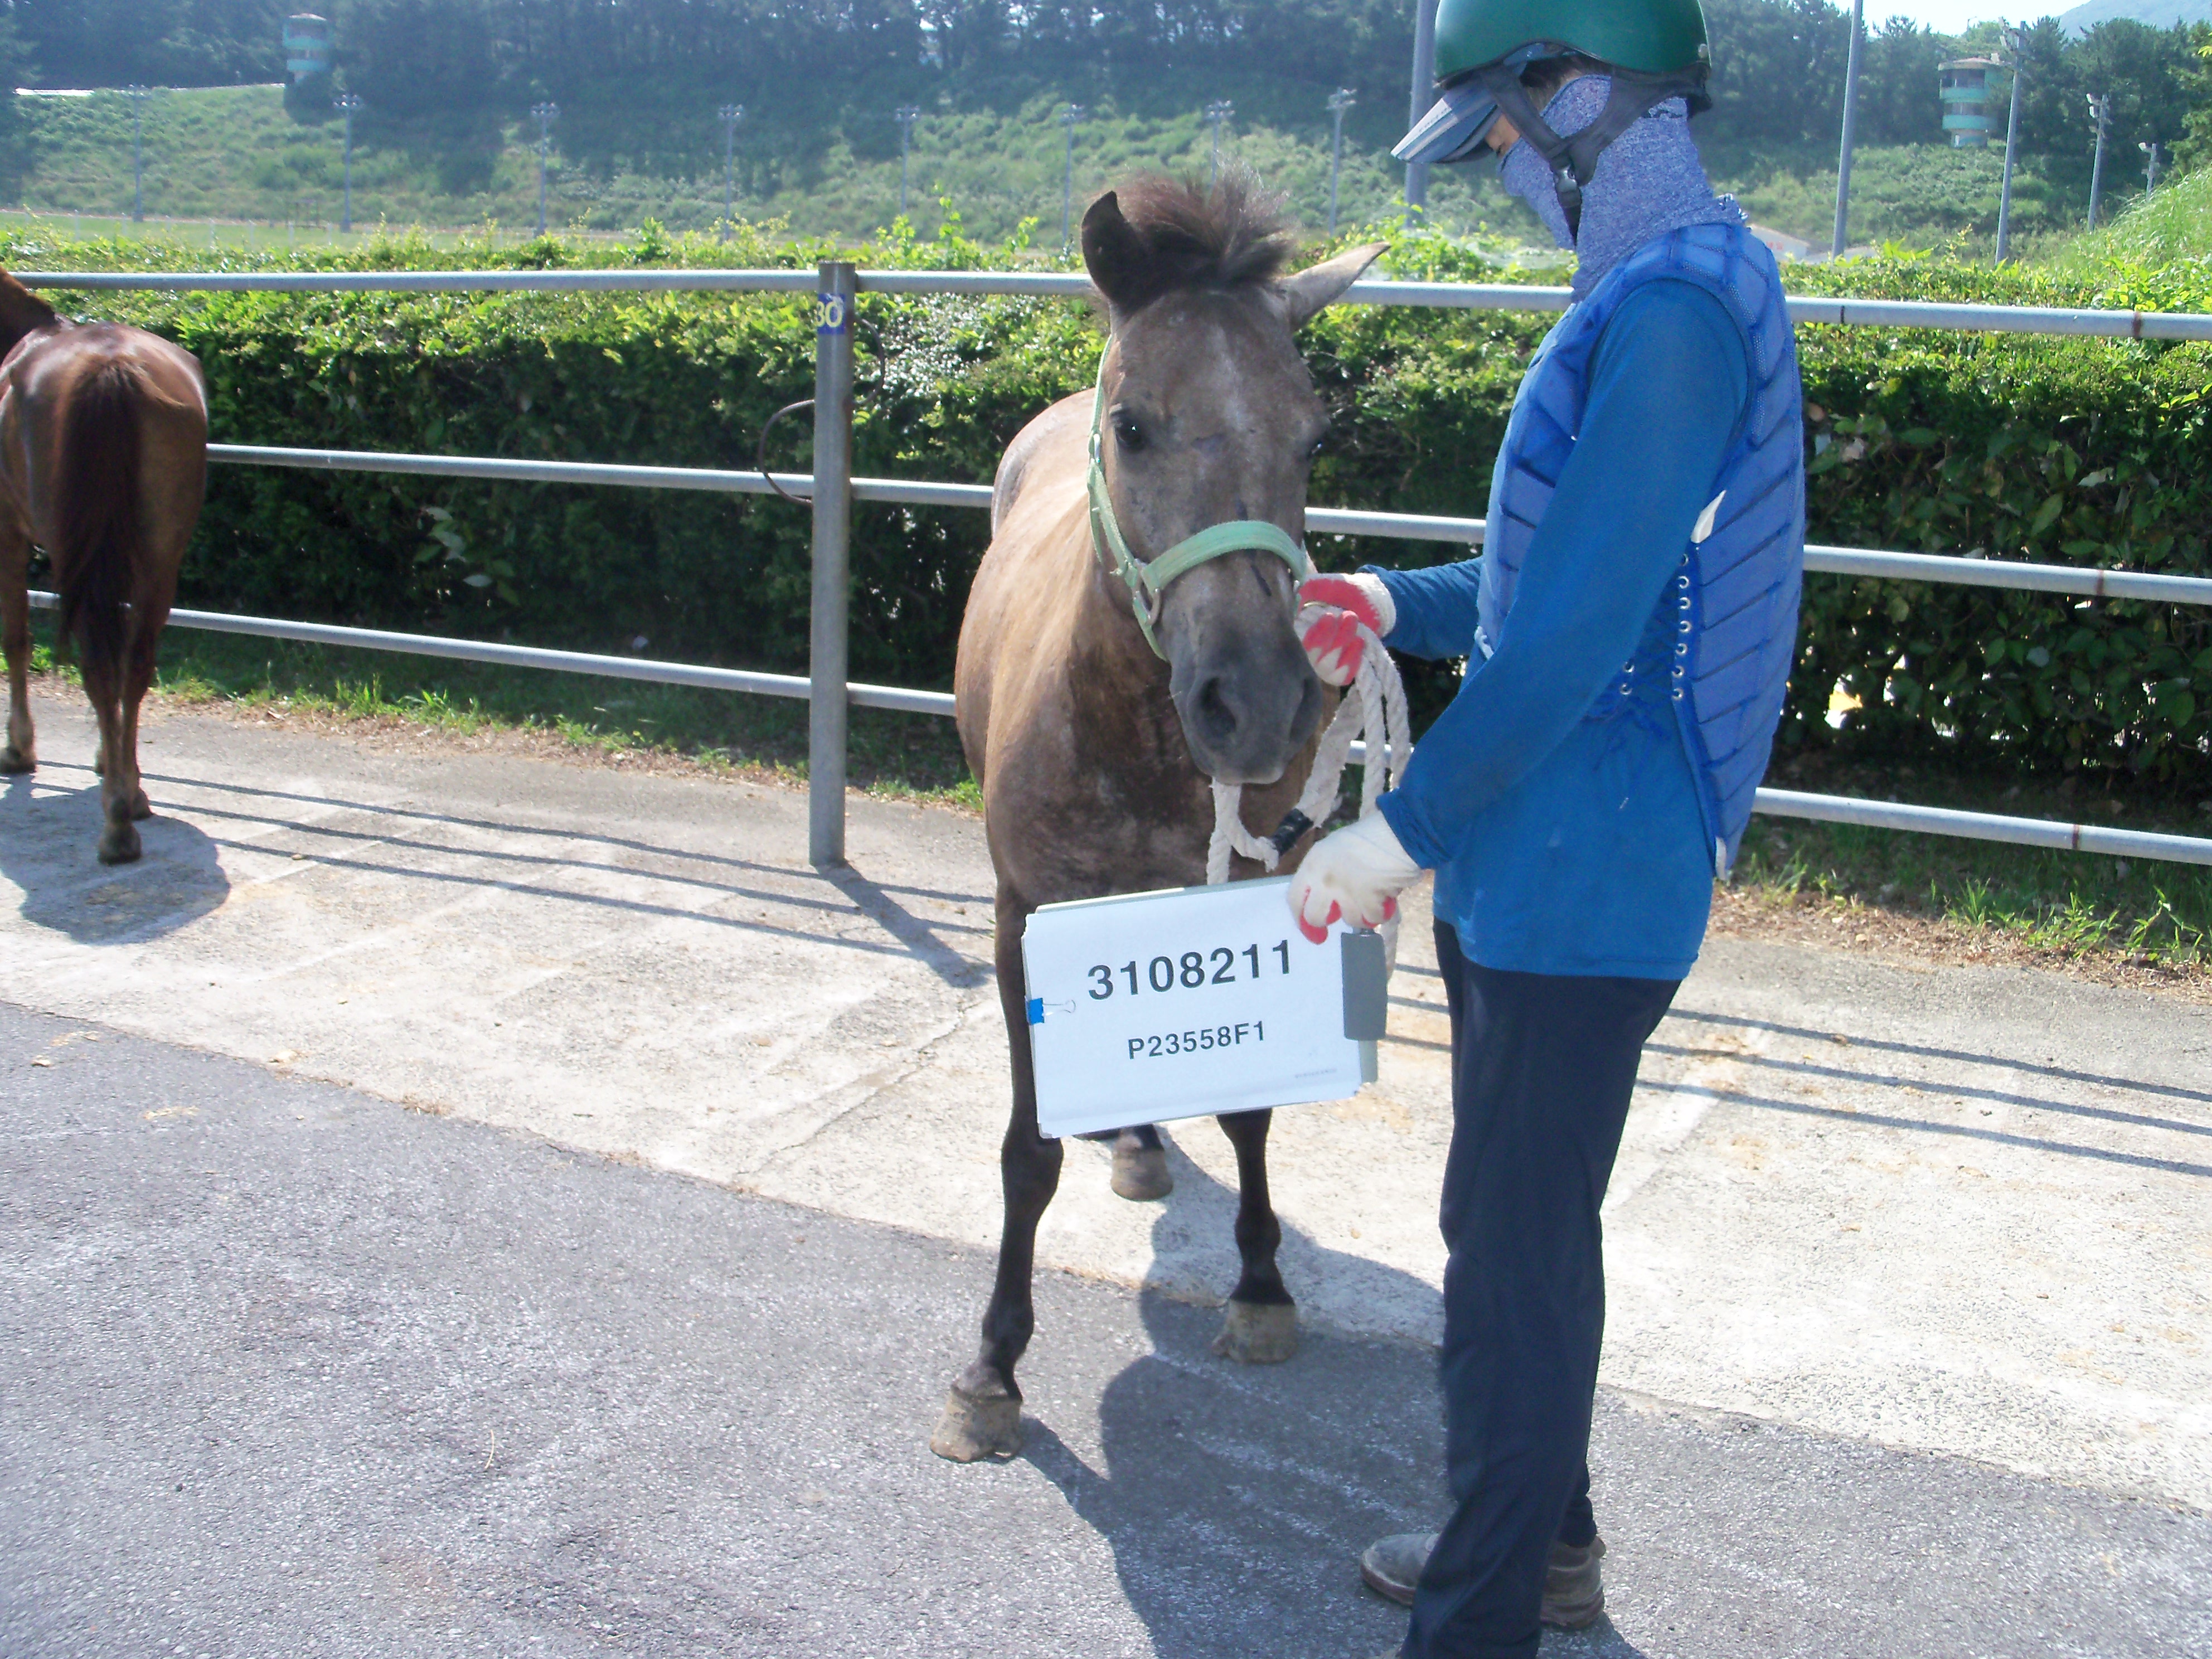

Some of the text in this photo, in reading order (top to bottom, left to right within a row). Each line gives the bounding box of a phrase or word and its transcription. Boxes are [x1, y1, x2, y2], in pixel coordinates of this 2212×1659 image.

[814, 301, 843, 328] 30
[1088, 939, 1291, 1001] 3108211
[1128, 1021, 1264, 1060] P23558F1
